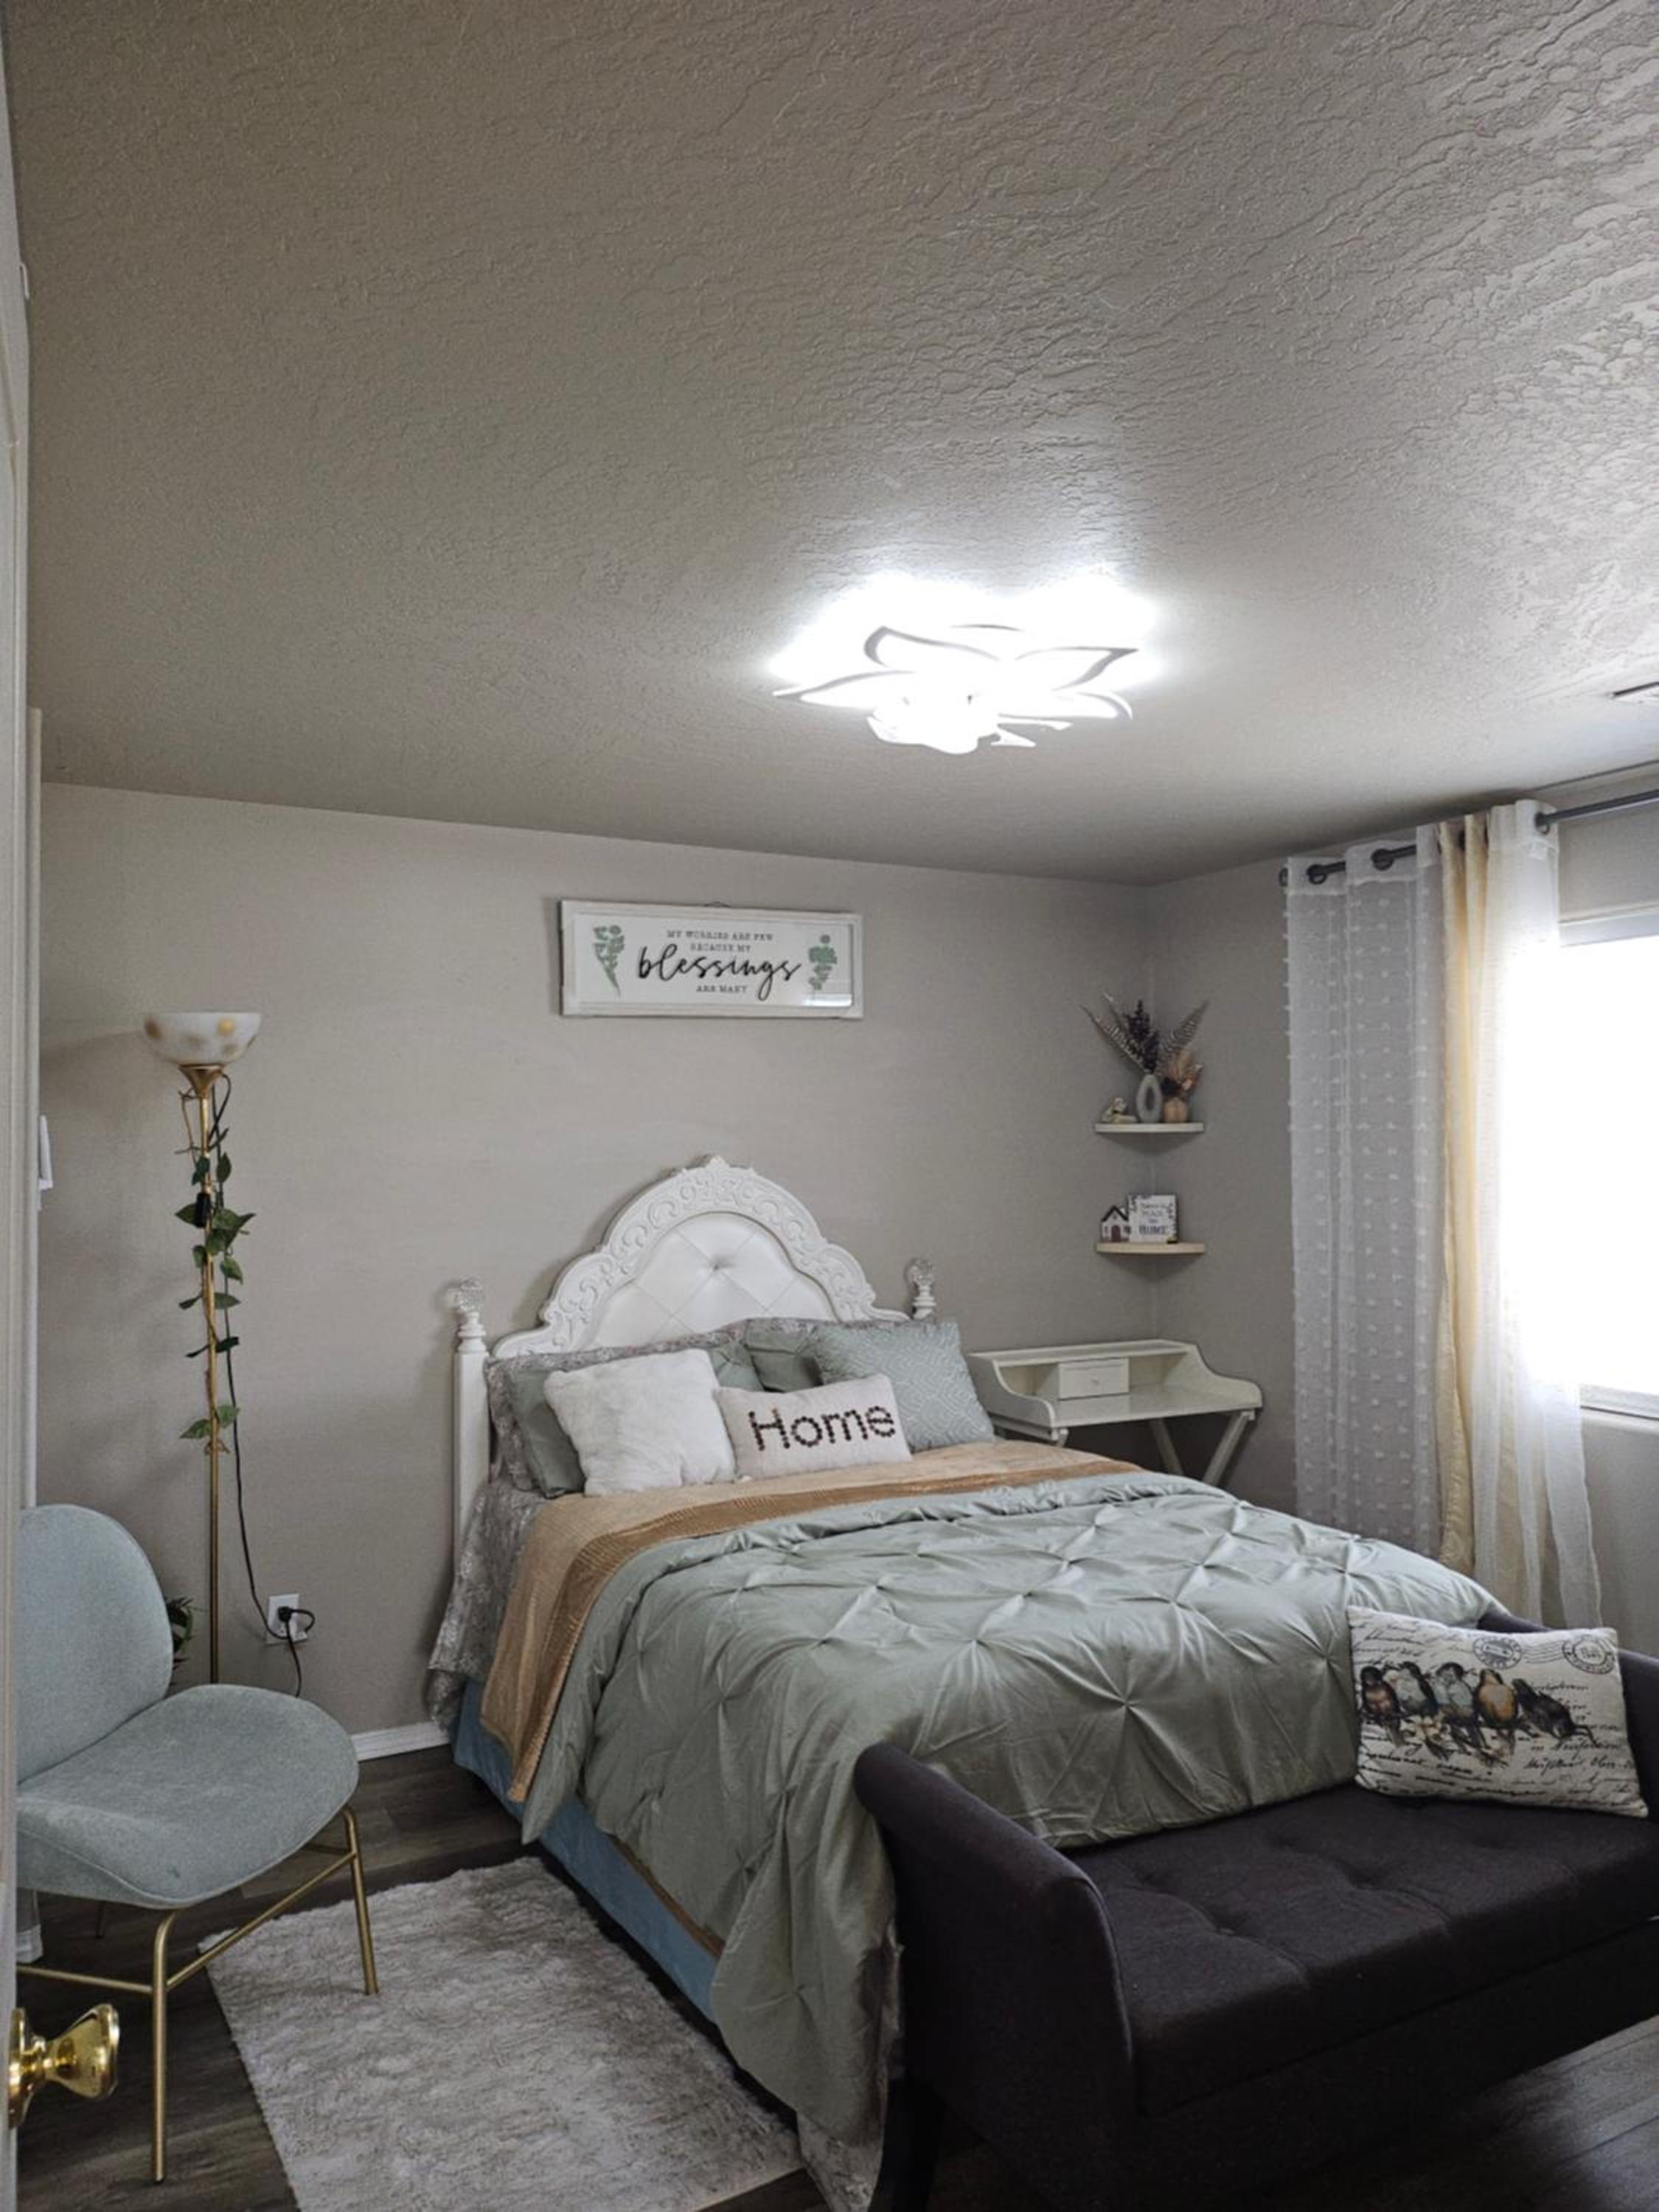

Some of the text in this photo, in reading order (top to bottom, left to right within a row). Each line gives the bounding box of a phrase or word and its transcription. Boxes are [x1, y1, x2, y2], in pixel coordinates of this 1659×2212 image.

[667, 930, 682, 938] MY
[731, 932, 751, 941] ARE
[737, 945, 751, 953] MY
[639, 943, 802, 1001] blessings
[696, 984, 748, 993] ARE MANY
[748, 1405, 896, 1451] Home
